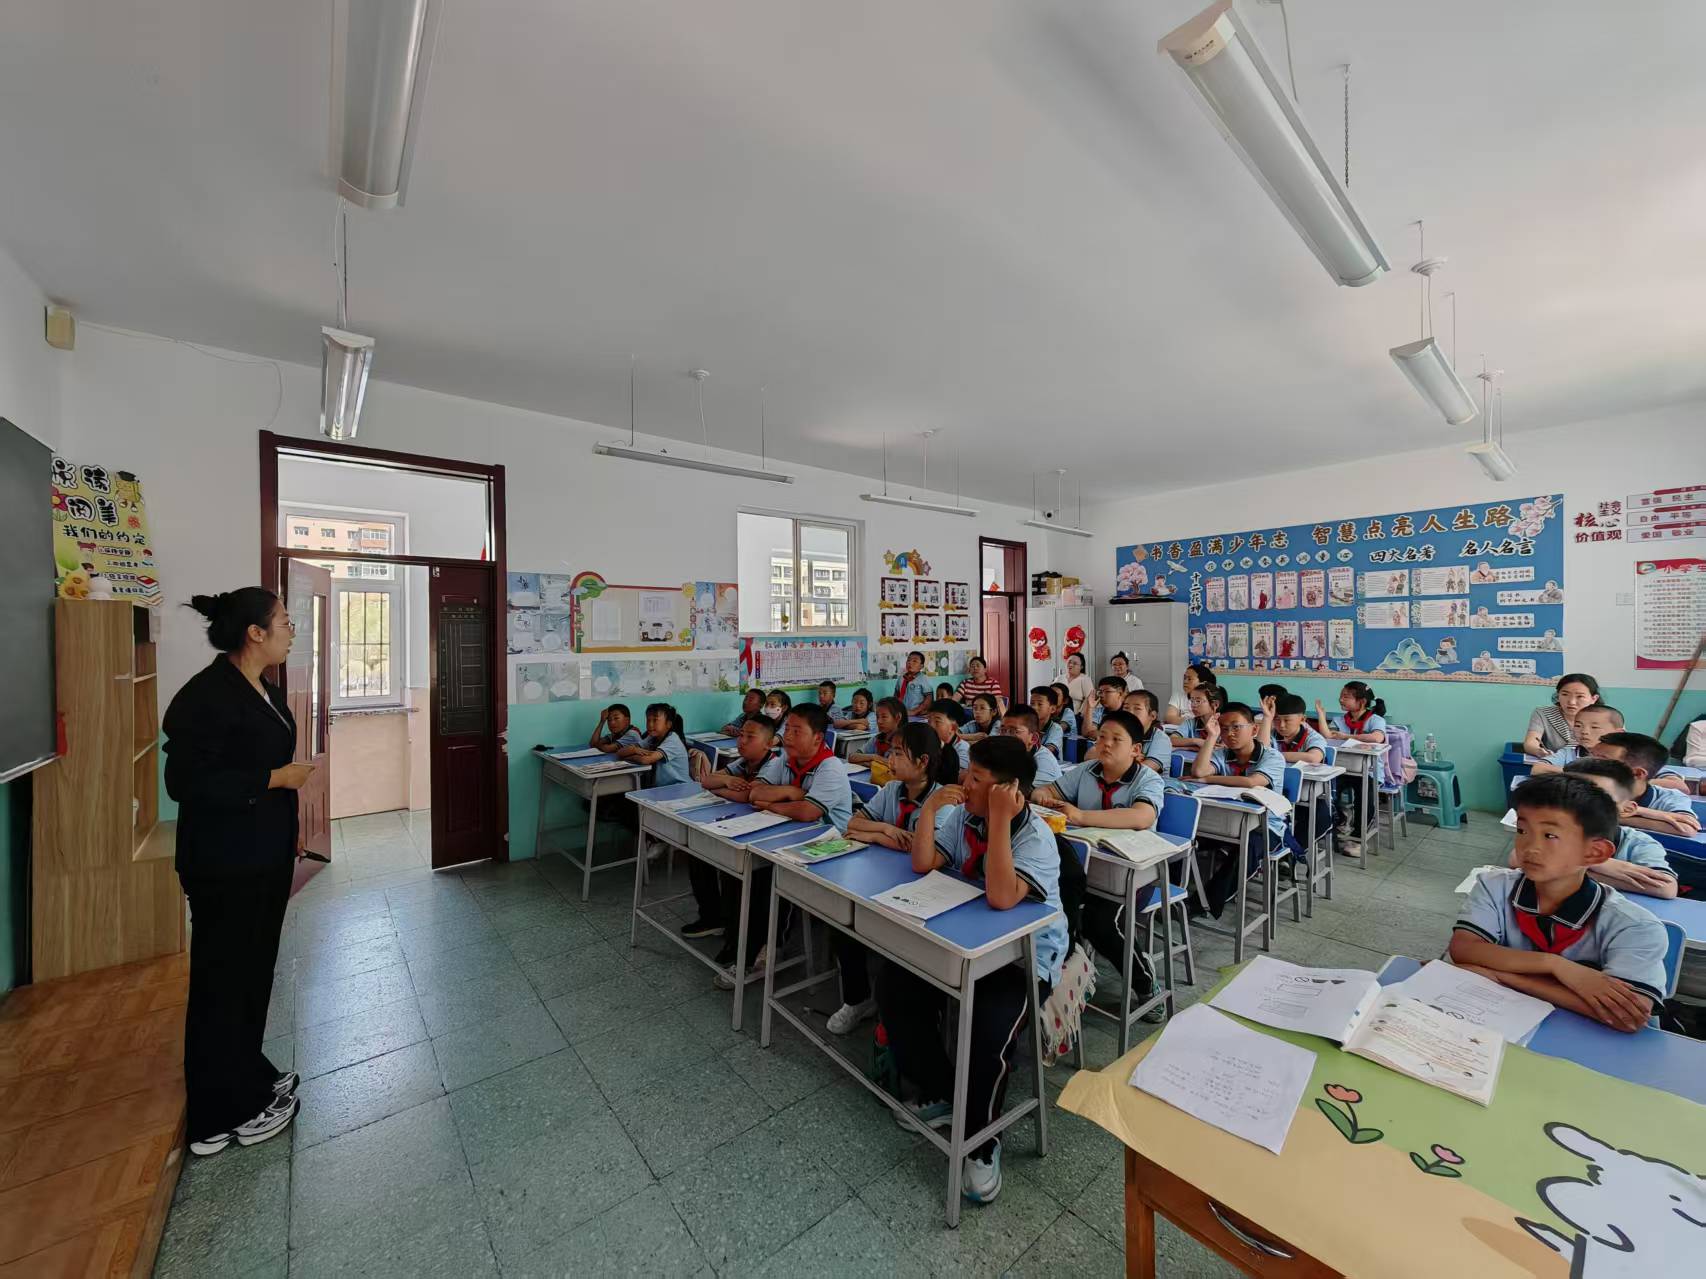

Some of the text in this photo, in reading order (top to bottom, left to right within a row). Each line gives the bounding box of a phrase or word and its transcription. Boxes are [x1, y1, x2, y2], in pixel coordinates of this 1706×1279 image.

[1574, 512, 1620, 528] 核心
[63, 524, 146, 545] 我们的约定
[1151, 504, 1516, 560] 书香盈满少年志 智慧点亮人生路
[1575, 530, 1622, 543] 价值观
[1370, 545, 1435, 563] 四大名著
[1459, 538, 1536, 557] 名人名言
[1189, 572, 1203, 616] 十二花神
